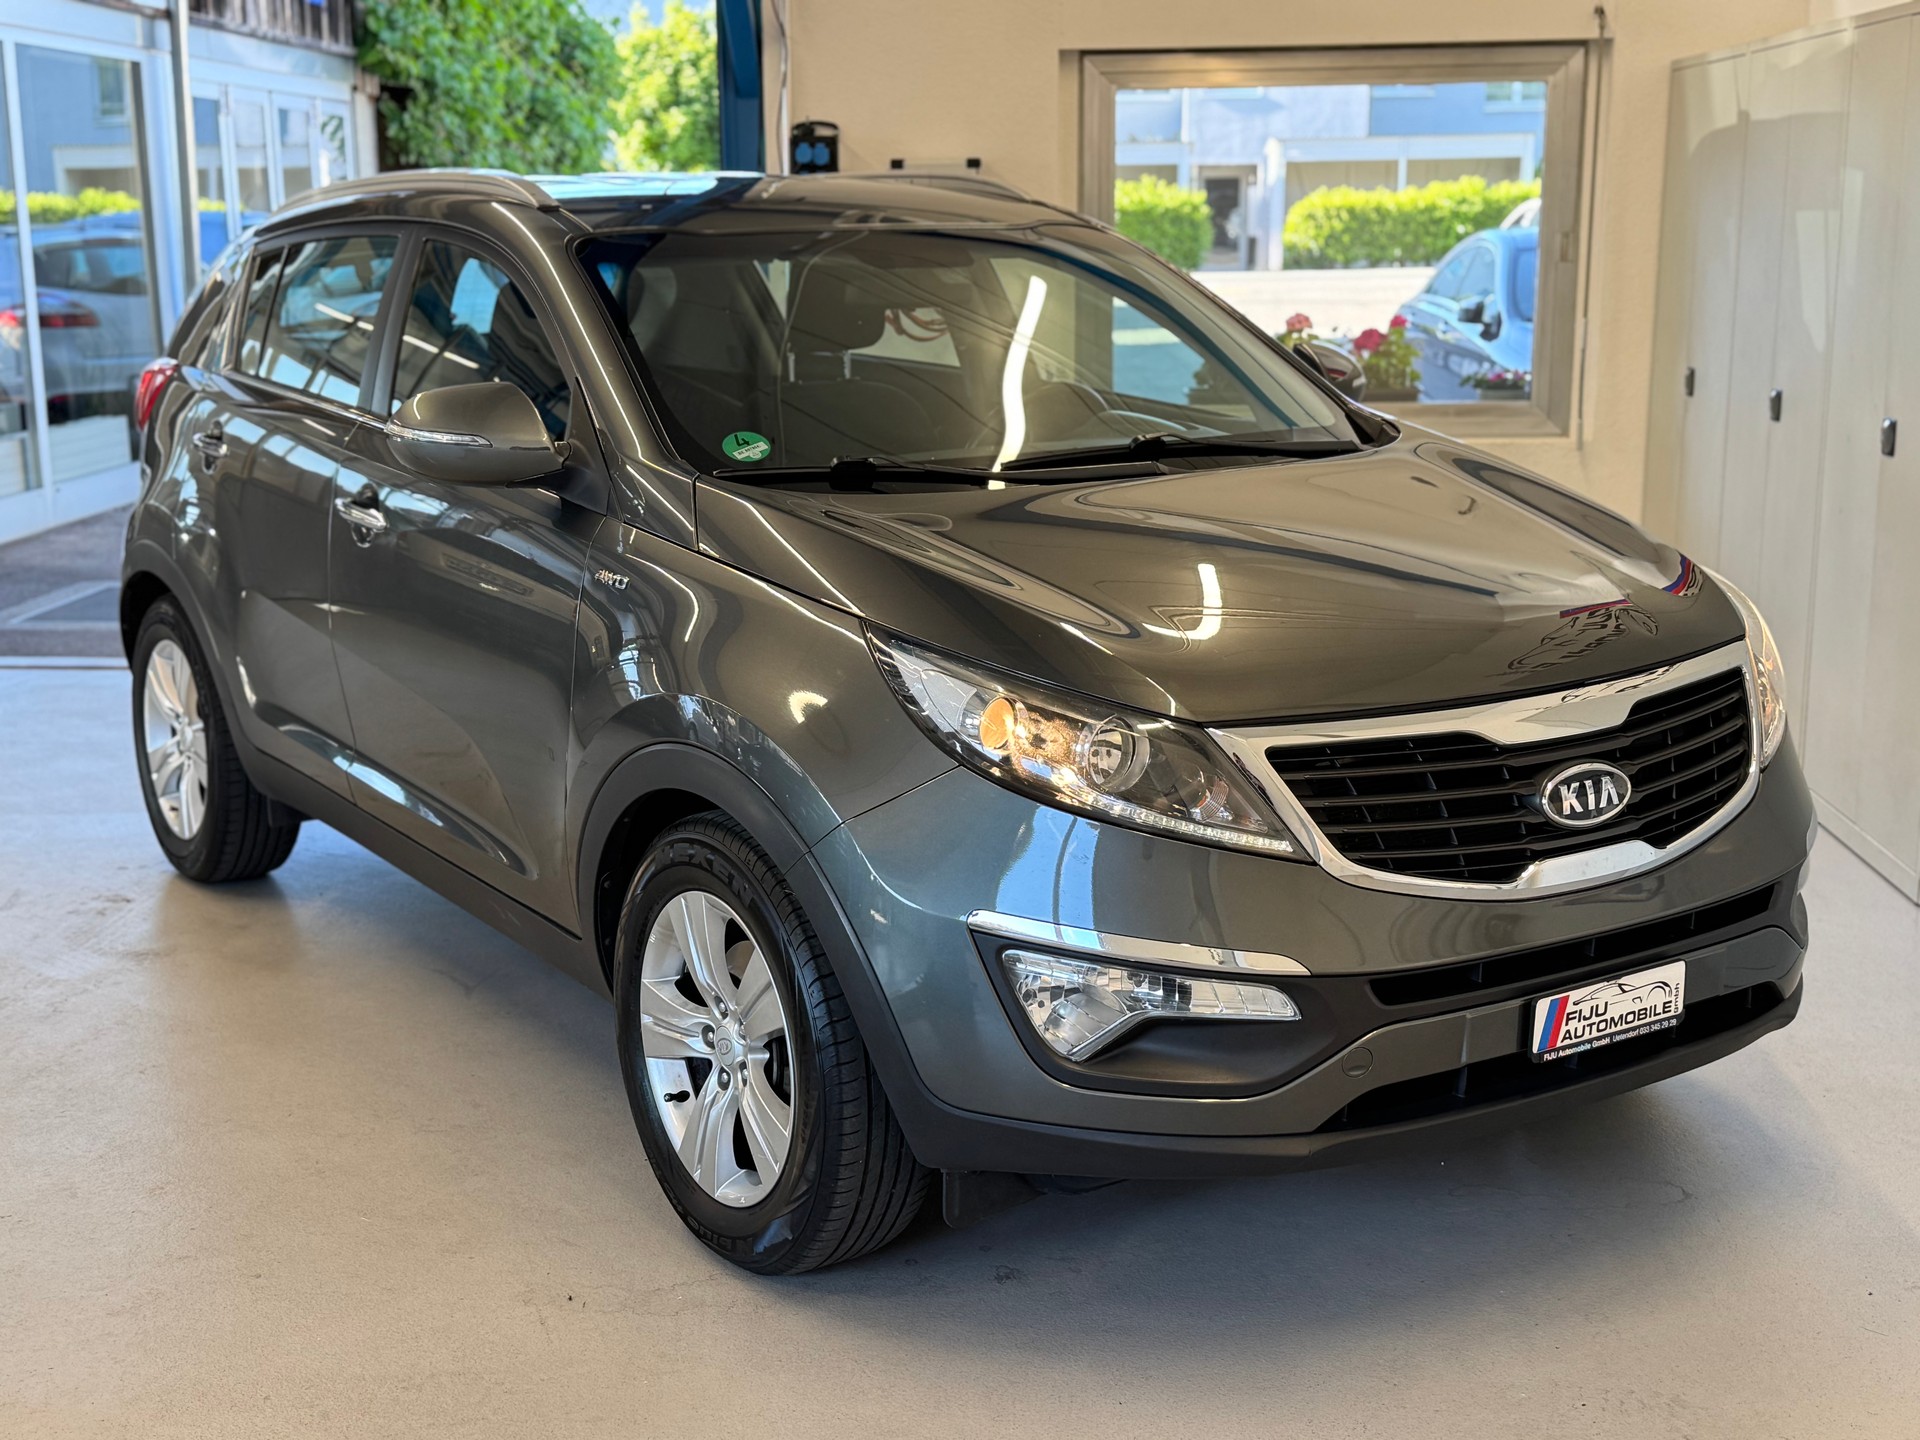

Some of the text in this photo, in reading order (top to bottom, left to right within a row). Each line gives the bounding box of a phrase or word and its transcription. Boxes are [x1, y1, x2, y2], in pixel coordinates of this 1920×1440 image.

[734, 433, 750, 447] 4
[1558, 775, 1620, 815] KIA
[654, 843, 755, 907] NEXEN
[1560, 1000, 1673, 1043] AUTOMOBILE
[1565, 1001, 1609, 1026] FIJU
[1544, 1050, 1557, 1061] FIJU
[1558, 1043, 1591, 1057] Automobile
[1592, 1036, 1611, 1048] GmbH
